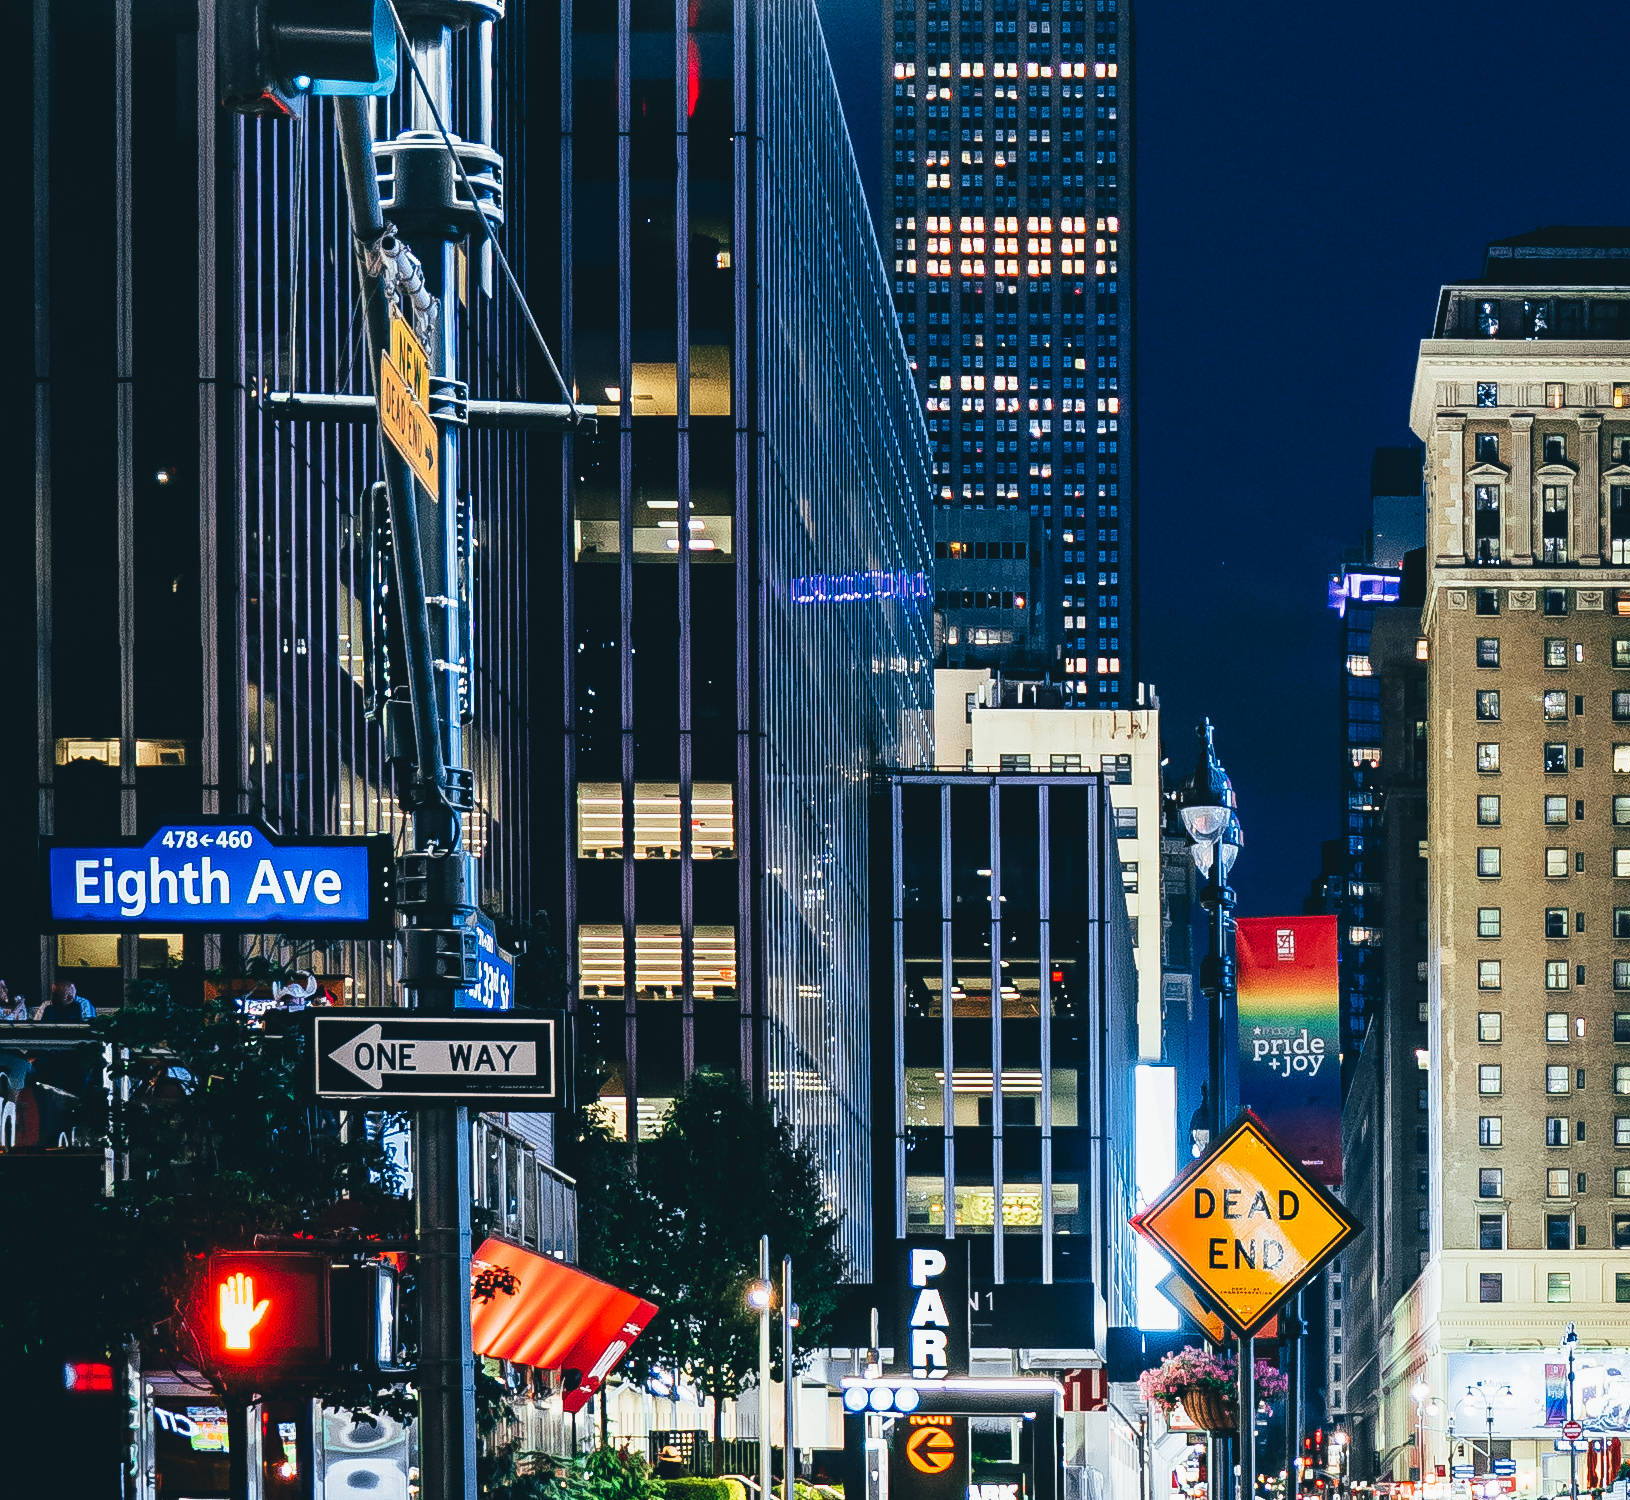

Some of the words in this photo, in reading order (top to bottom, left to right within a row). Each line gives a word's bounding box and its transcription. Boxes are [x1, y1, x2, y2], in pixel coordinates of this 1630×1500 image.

[399, 330, 422, 400] NEW
[386, 376, 405, 435] DEAD
[408, 408, 423, 459] END
[162, 830, 198, 849] 478
[215, 830, 252, 849] 460
[75, 857, 230, 917] Eighth
[246, 859, 342, 905] Ave
[354, 1042, 417, 1071] ONE
[449, 1043, 518, 1072] WAY
[1253, 1029, 1325, 1061] pride
[1194, 1187, 1300, 1221] DEAD
[1208, 1237, 1285, 1271] END
[911, 1248, 950, 1379] PAR
